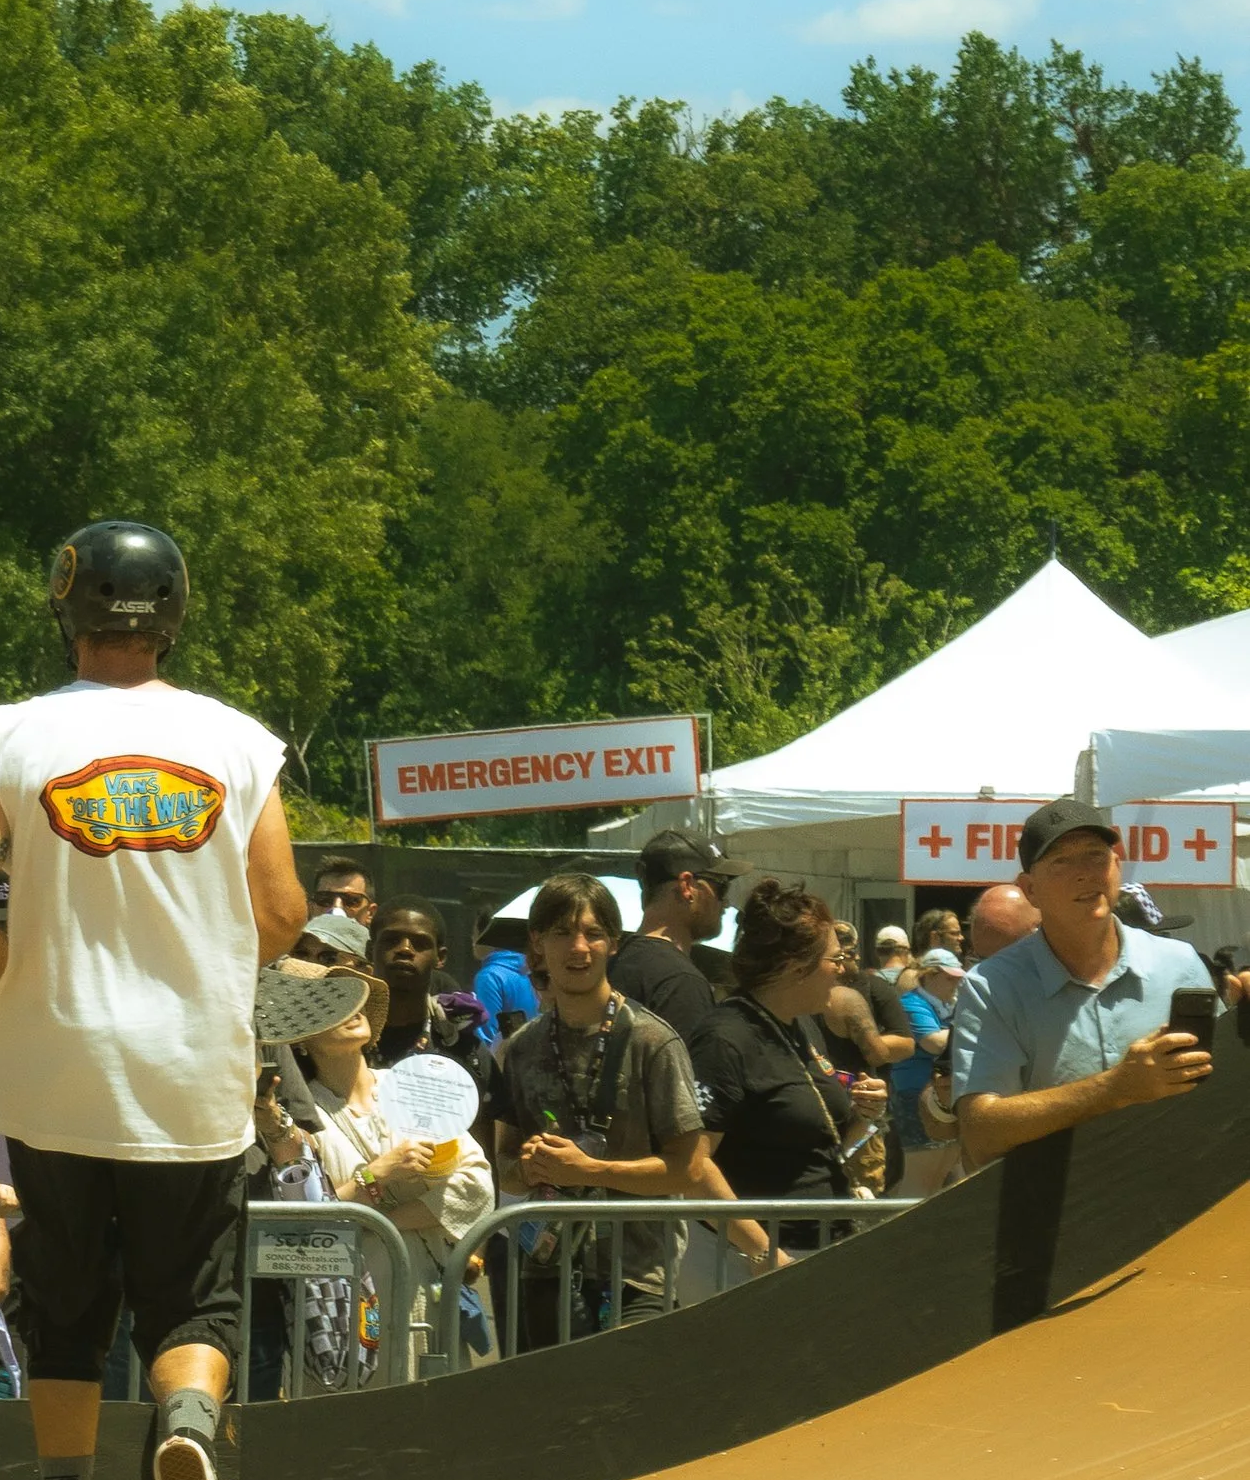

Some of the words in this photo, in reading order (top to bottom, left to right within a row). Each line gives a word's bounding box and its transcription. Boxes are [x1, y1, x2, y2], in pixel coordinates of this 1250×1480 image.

[110, 601, 156, 614] LASEK
[398, 751, 596, 795] EMERGENCY
[603, 745, 676, 778] EXIT
[111, 795, 153, 825] THE
[265, 1254, 349, 1263] SONCOrentals.com
